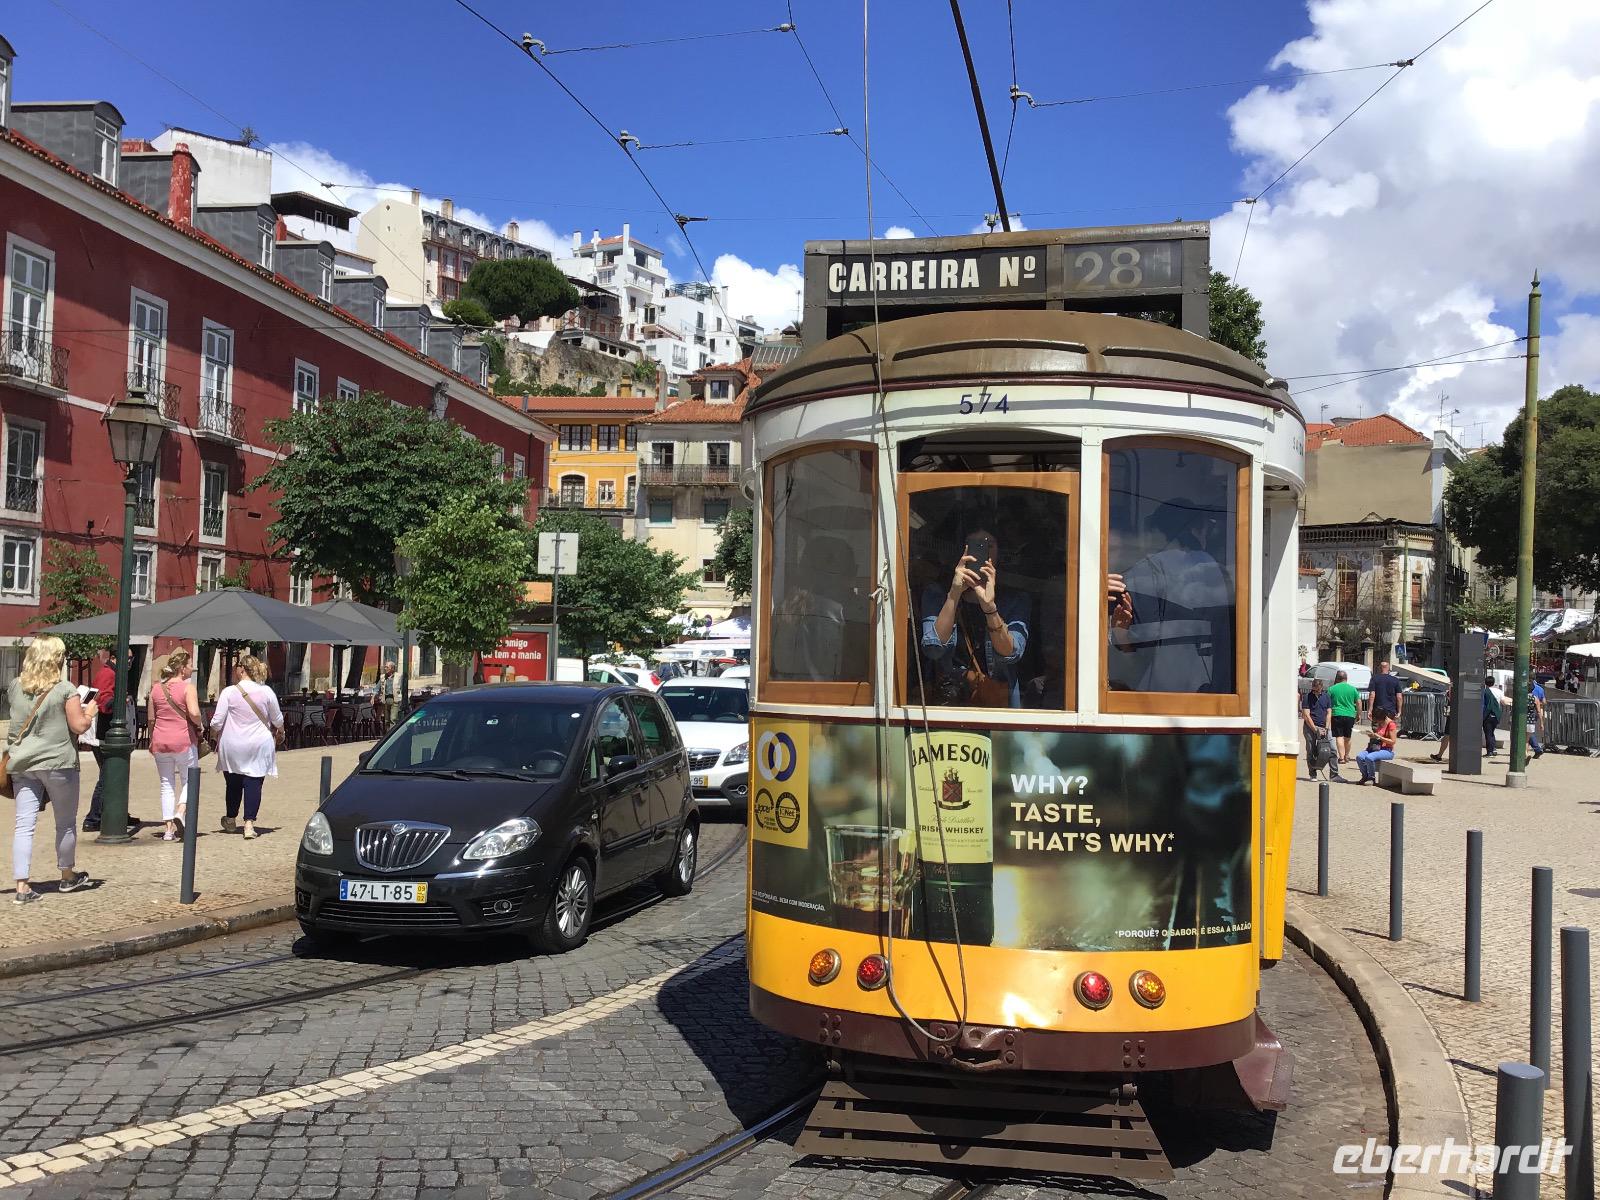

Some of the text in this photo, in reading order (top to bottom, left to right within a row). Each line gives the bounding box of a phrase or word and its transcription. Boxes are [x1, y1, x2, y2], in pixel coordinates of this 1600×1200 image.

[828, 256, 981, 293] CARREIRA
[1073, 246, 1143, 291] 28
[959, 393, 1010, 415] 574
[494, 649, 510, 659] tem
[510, 652, 517, 660] a
[518, 651, 542, 660] mania
[911, 743, 990, 770] JAMESON
[1010, 773, 1089, 796] WHY?
[1010, 802, 1101, 828] TASTE,
[945, 826, 985, 834] WHISKEY
[1010, 830, 1102, 853] THAT'S
[1161, 929, 1169, 937] O
[1200, 925, 1206, 935] É
[1207, 925, 1225, 935] ESSA
[1226, 925, 1231, 933] A
